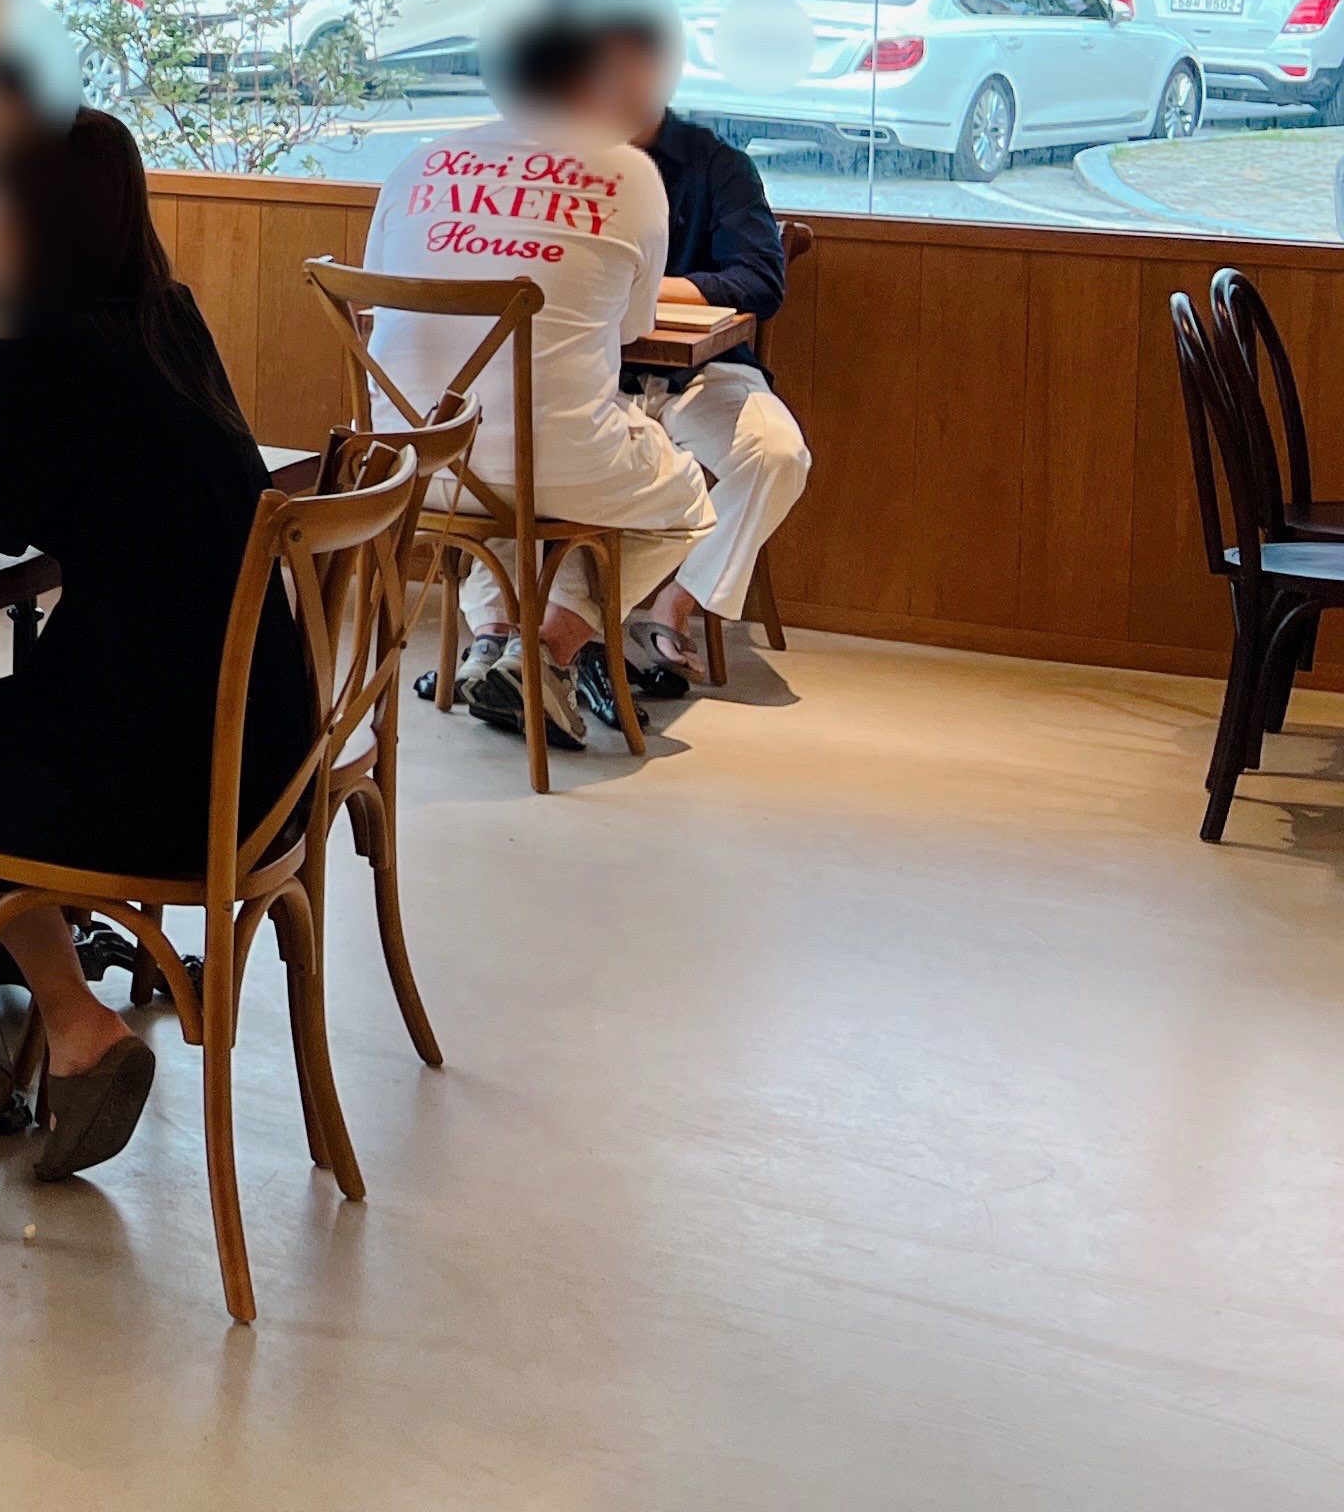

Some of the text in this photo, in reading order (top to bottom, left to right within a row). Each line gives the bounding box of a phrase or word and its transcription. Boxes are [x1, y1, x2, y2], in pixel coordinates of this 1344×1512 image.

[422, 149, 514, 178] Kiri
[406, 182, 619, 236] BAKERY
[427, 220, 565, 263] House
